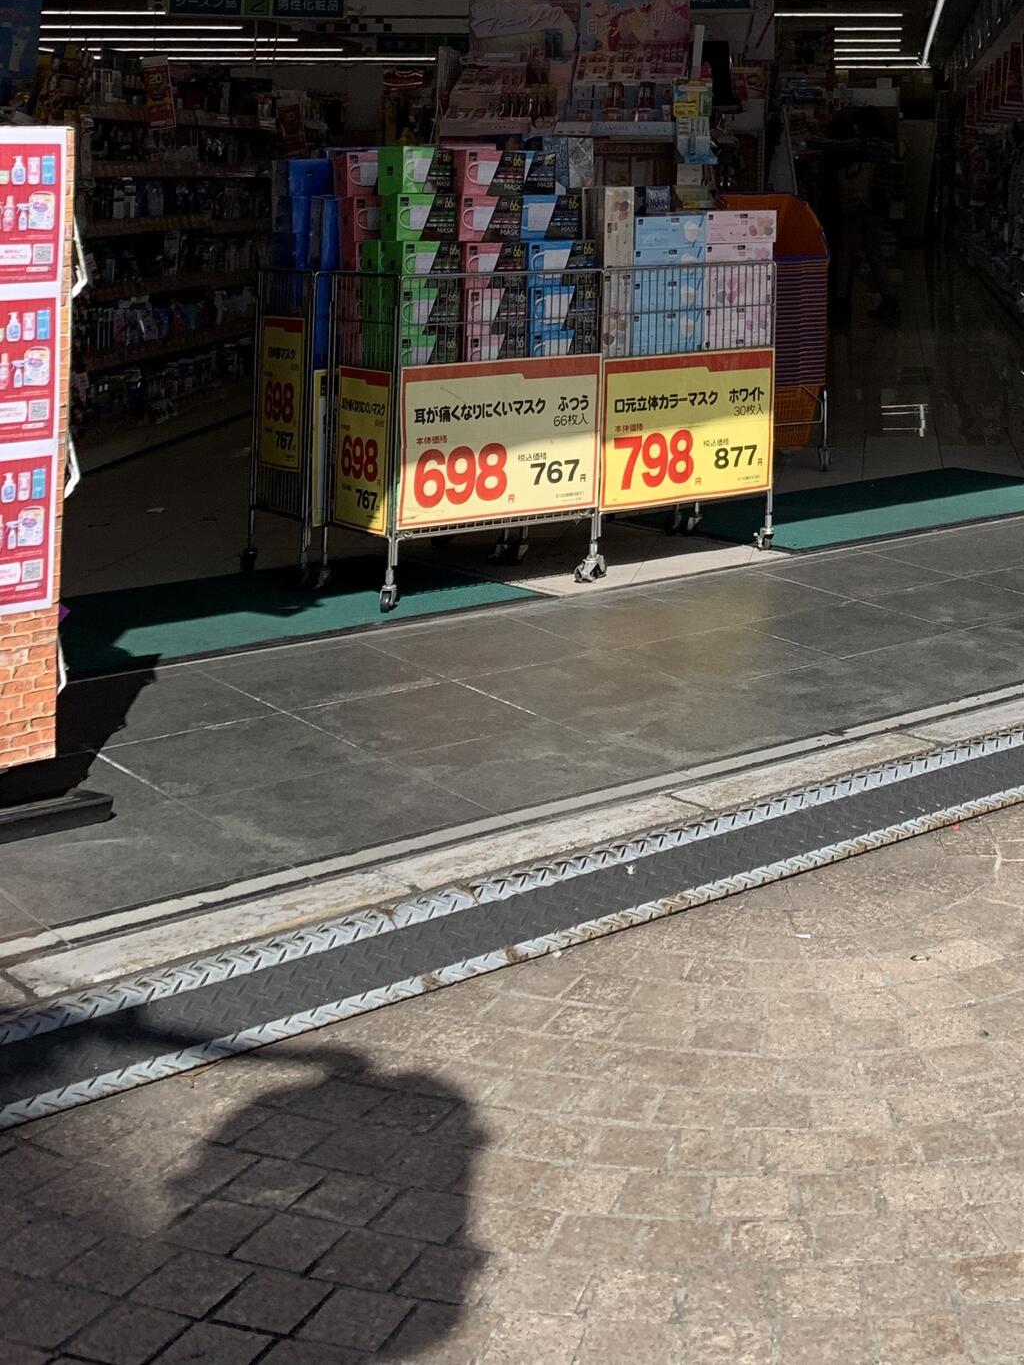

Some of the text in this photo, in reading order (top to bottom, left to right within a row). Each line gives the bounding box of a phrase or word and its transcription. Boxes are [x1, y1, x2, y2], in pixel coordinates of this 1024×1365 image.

[504, 183, 522, 191] MASK
[500, 228, 519, 236] MASK
[264, 380, 295, 424] 698
[414, 394, 589, 425] 耳が痛くなりにくいマスク ふつう
[614, 386, 765, 414] 口元立体カラーマスク ホワイト
[734, 404, 764, 417] 30枚入
[553, 413, 589, 427] 66枚入
[614, 423, 644, 433] 本体価格
[275, 430, 294, 451] 767
[416, 435, 448, 445] 本体価格
[341, 434, 378, 483] 698
[517, 452, 547, 462] 税込価格
[613, 429, 694, 491] 798
[714, 444, 758, 470] 877
[414, 442, 508, 509] 698
[530, 458, 580, 486] 767
[354, 488, 378, 511] 767
